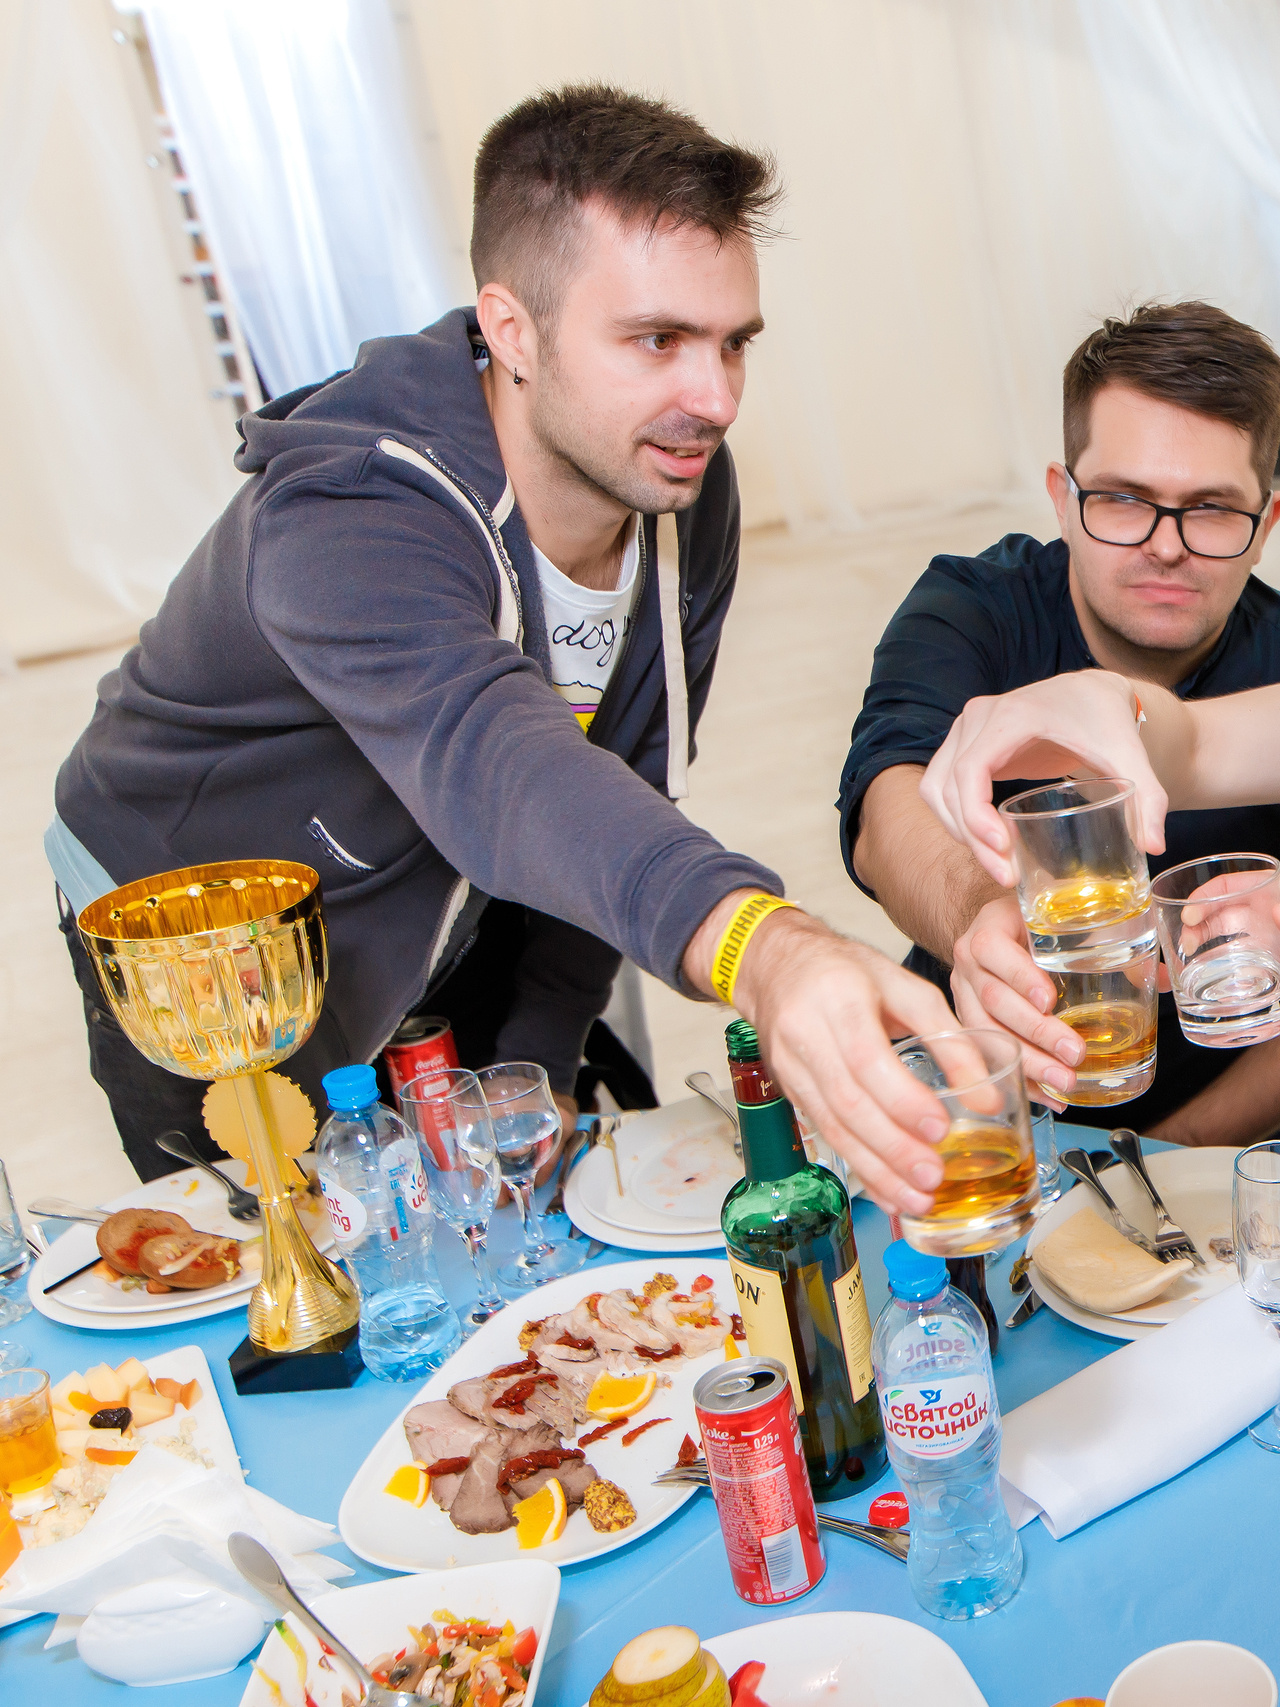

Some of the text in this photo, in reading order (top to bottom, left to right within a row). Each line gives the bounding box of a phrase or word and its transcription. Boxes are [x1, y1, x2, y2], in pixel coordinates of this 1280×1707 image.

[716, 897, 769, 999] ЫПОЛНИМ
[734, 1272, 761, 1306] ON
[847, 1268, 864, 1301] JAM
